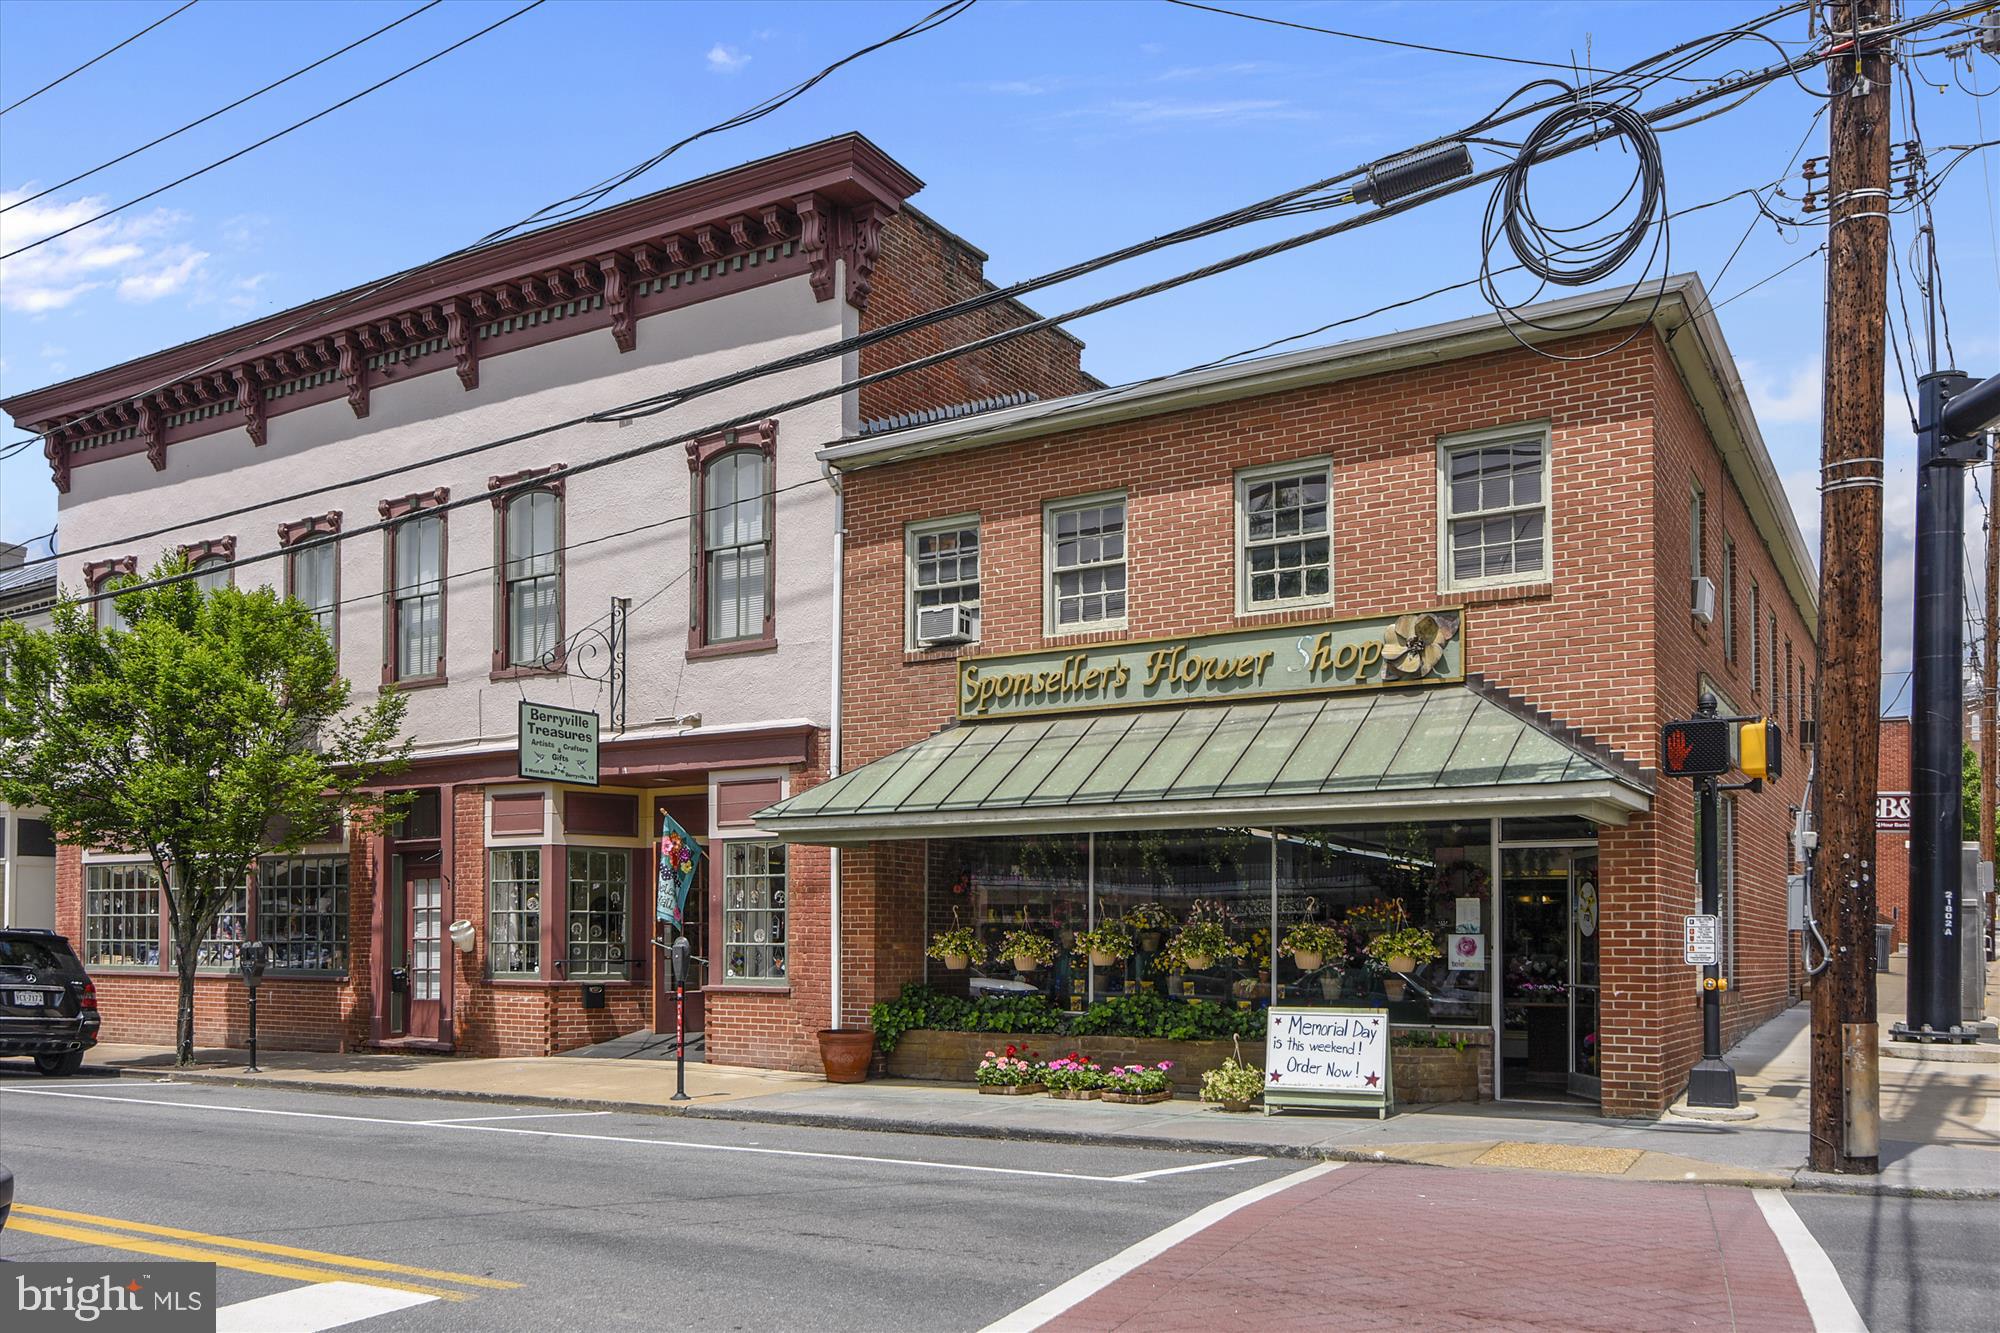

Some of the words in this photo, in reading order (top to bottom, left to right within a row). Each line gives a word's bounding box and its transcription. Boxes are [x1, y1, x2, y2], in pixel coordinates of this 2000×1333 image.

[963, 654, 1130, 711] Sponseller's
[1142, 644, 1274, 686] Flower
[1287, 631, 1383, 680] Shop
[530, 708, 589, 728] Berryville
[527, 722, 592, 743] Treasures
[531, 739, 554, 748] Artists
[563, 743, 588, 753] Crafters
[551, 753, 569, 762] Gifts
[1288, 1015, 1348, 1037] Memorial
[1352, 1019, 1377, 1045] Day
[1273, 1036, 1282, 1049] is
[1287, 1037, 1304, 1051] this
[1286, 1056, 1322, 1074] Order
